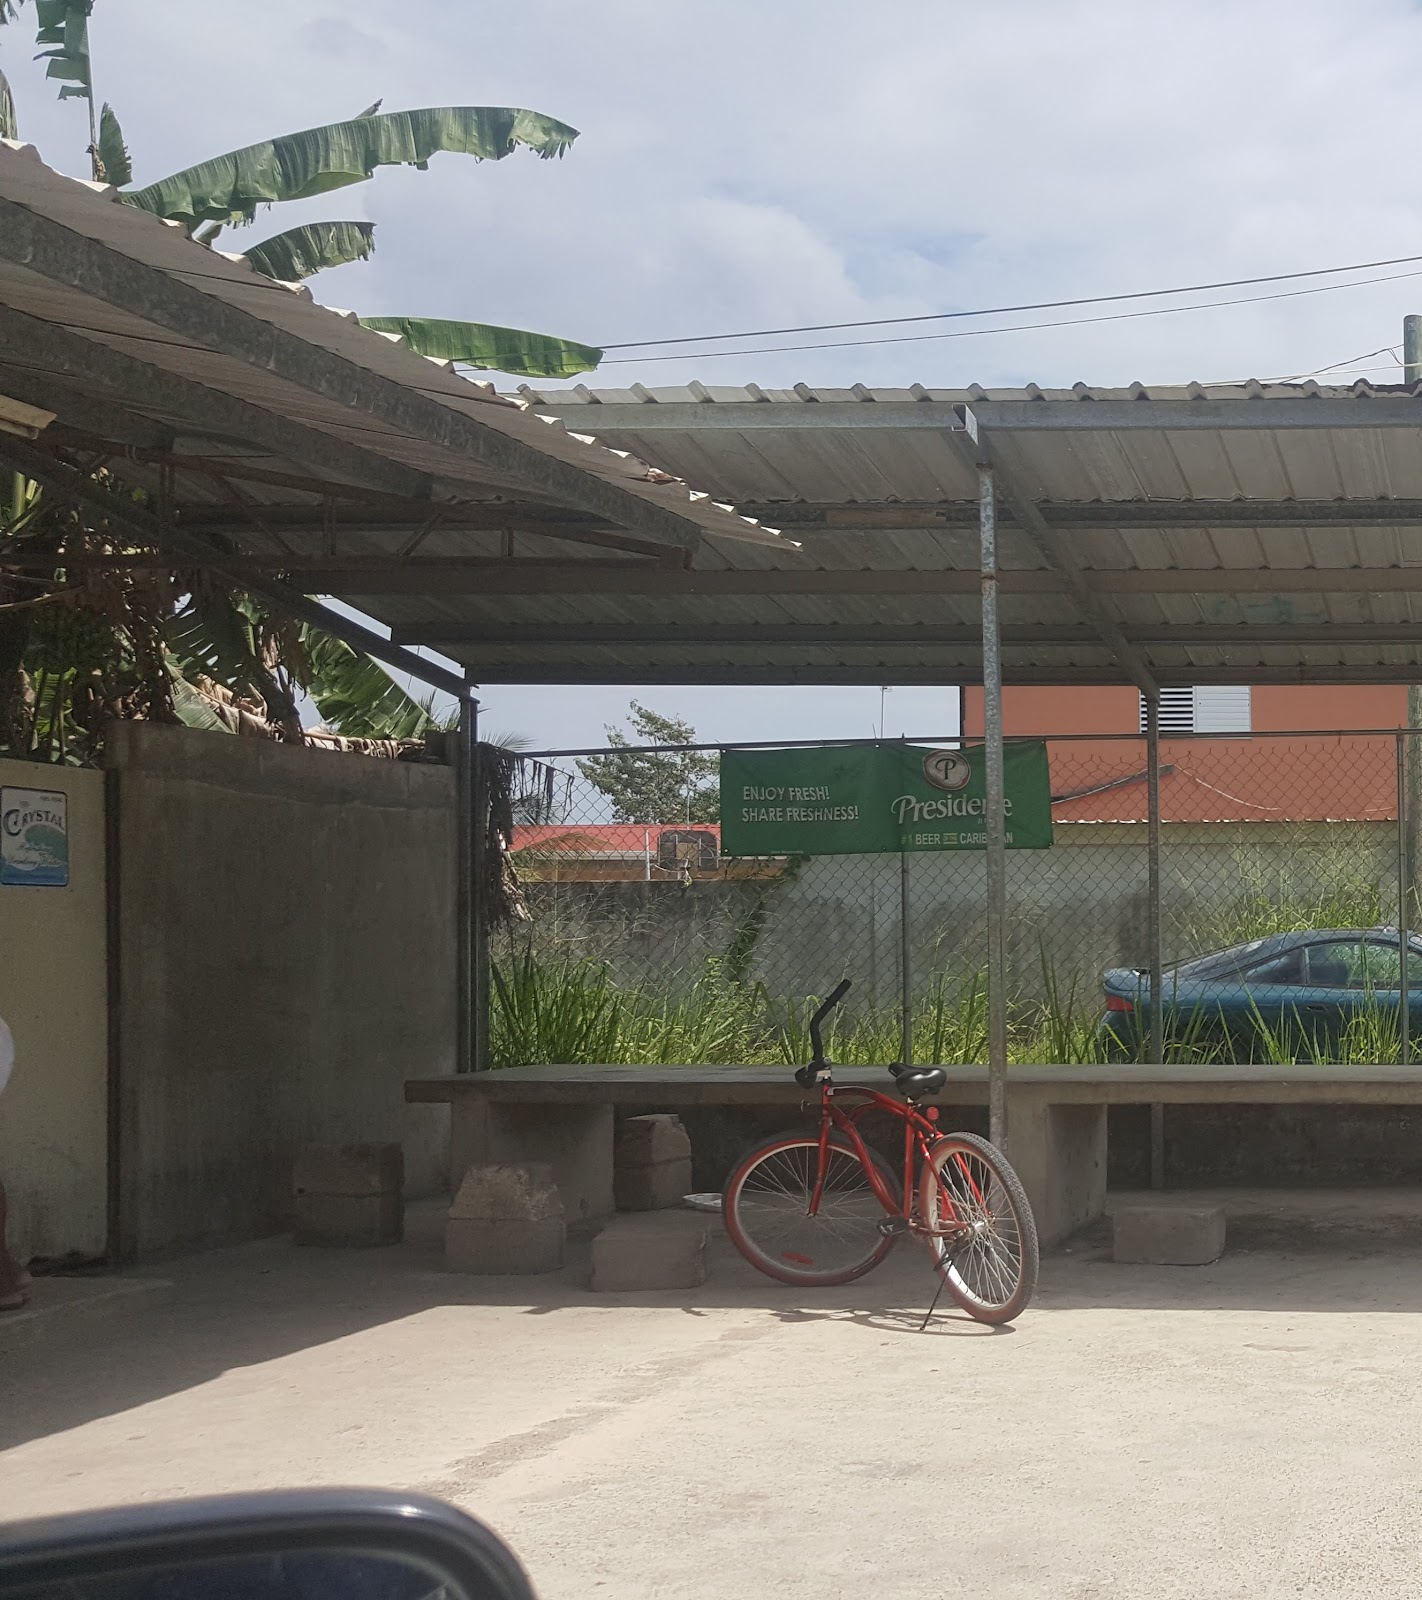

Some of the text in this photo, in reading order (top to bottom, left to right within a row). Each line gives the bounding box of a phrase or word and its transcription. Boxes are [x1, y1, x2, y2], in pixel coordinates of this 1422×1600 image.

[743, 785, 831, 801] ENJOY FRESH!
[742, 805, 860, 822] SHARE FRESHNESS!
[3, 808, 65, 837] CRYSTAL
[915, 833, 941, 845] BEER
[960, 831, 1014, 844] CARIBN
